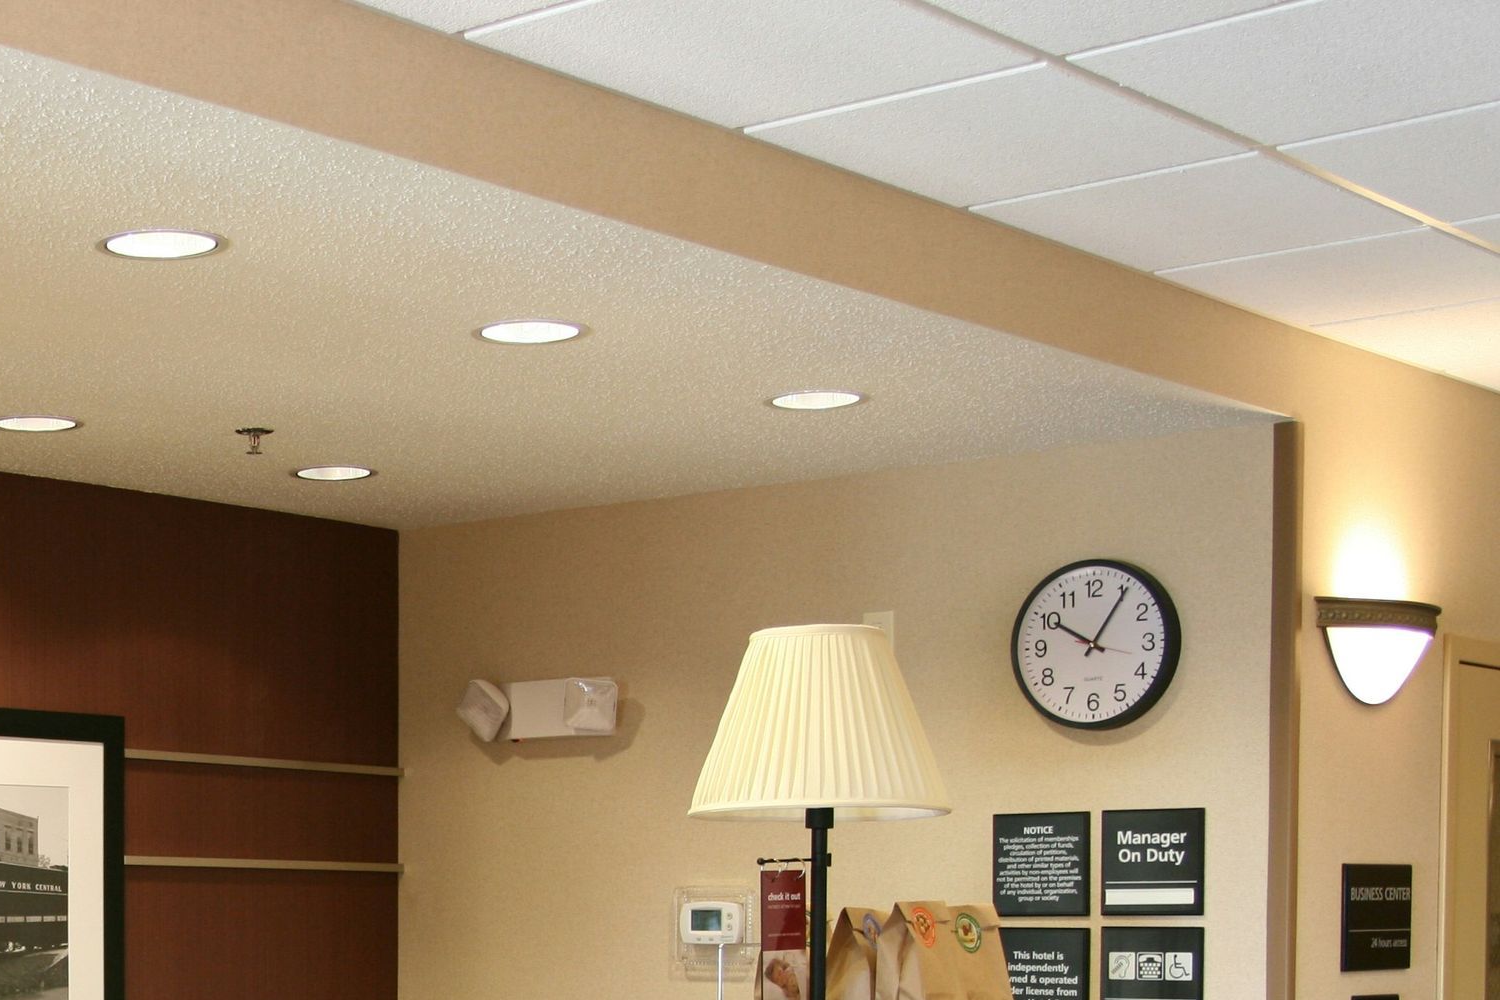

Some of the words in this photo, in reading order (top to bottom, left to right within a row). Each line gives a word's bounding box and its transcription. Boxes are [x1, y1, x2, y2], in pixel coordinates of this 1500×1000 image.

[1085, 579, 1103, 598] 12
[1060, 591, 1076, 608] 11
[1040, 611, 1061, 630] 10
[1136, 602, 1148, 621] 2
[1034, 639, 1047, 658] 9
[1141, 632, 1155, 651] 3
[1041, 667, 1054, 686] 8
[1134, 661, 1147, 680] 4
[1063, 686, 1075, 705] 7
[1087, 692, 1100, 711] 6
[1113, 683, 1127, 702] 5
[1023, 826, 1054, 835] NOTICE
[1116, 830, 1188, 848] Manager
[1118, 848, 1141, 863] On
[1146, 848, 1185, 866] Duty
[11, 881, 32, 890] YORK
[35, 883, 62, 892] CENTRAL
[1350, 887, 1383, 901] BUSINESS
[1384, 887, 1411, 901] CENTER
[1013, 951, 1030, 960] This
[1032, 951, 1055, 960] hotel
[1056, 951, 1064, 960] is
[1008, 962, 1069, 975] independently
[1009, 974, 1028, 983] ned
[1030, 975, 1037, 983] &
[1039, 976, 1078, 986] operated
[1025, 986, 1054, 996] license
[1056, 986, 1078, 996] from
